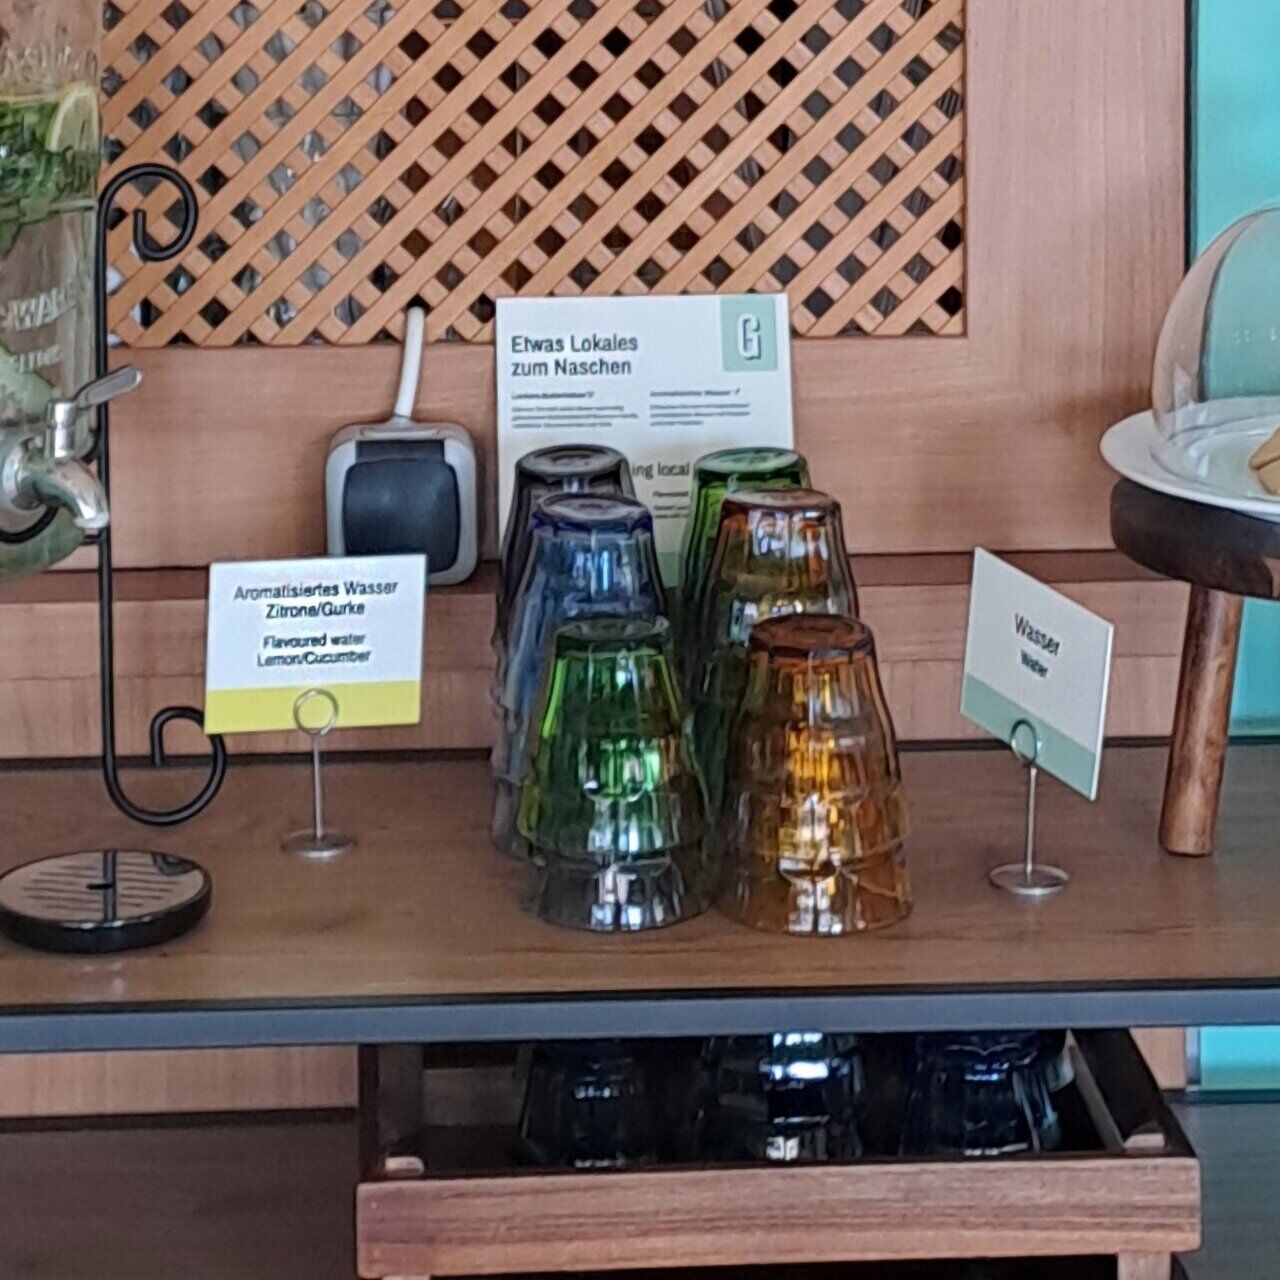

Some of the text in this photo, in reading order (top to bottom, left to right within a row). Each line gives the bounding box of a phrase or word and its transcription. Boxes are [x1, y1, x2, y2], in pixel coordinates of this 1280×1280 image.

[511, 333, 639, 354] Etwas Lokales
[511, 358, 632, 377] zum Naschen
[233, 580, 399, 602] Aromatisiertes Wasser
[265, 601, 366, 620] Zitrone/Gurke
[262, 632, 366, 650] Flavoured water
[1014, 612, 1061, 657] Wasser
[256, 650, 372, 669] Lemon/Cucumber
